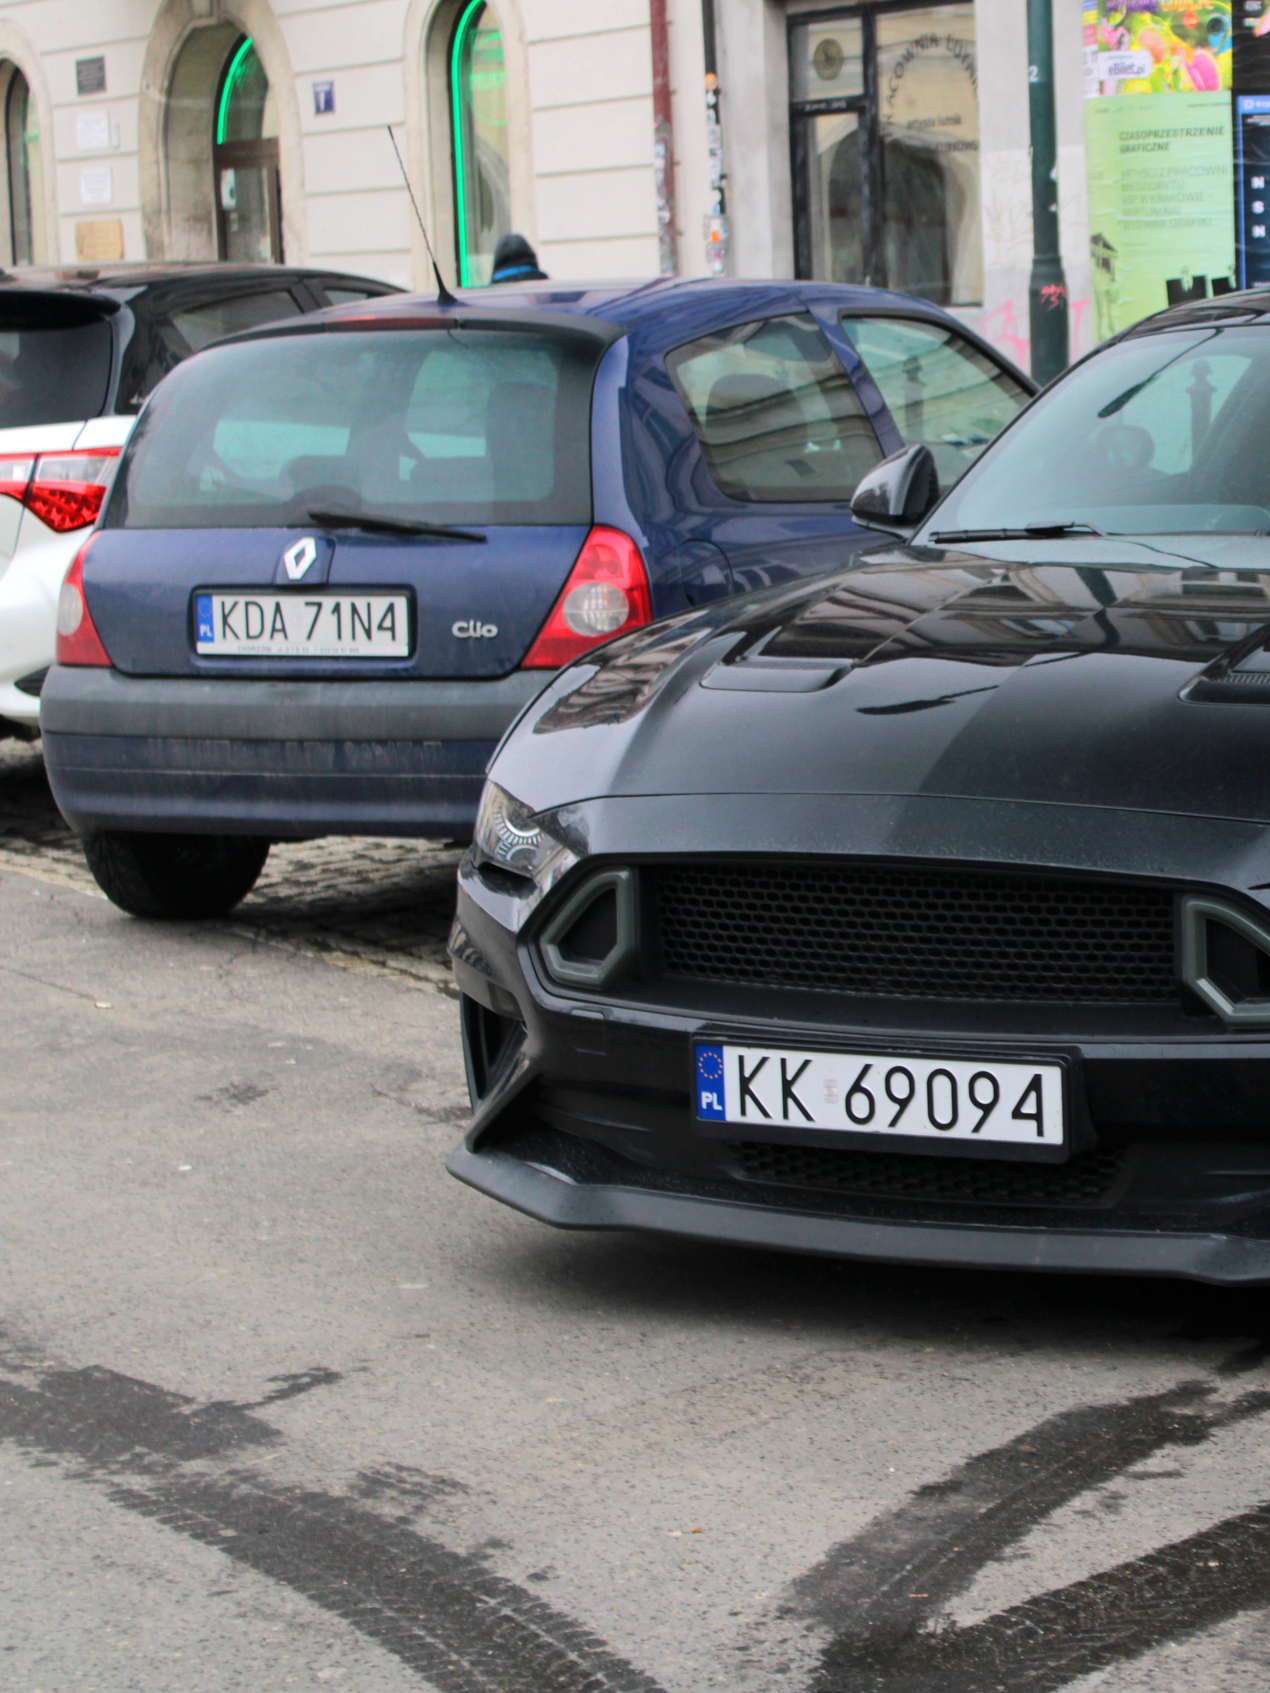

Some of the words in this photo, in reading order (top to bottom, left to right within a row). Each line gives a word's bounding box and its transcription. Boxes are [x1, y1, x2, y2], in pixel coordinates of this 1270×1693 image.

[1120, 142, 1171, 154] GRAFICZNE
[200, 623, 213, 638] PL
[221, 601, 288, 642] KDA
[304, 601, 396, 642] 71N4
[701, 1091, 723, 1111] PL
[736, 1054, 817, 1123] KK
[845, 1063, 1045, 1138] 69094
